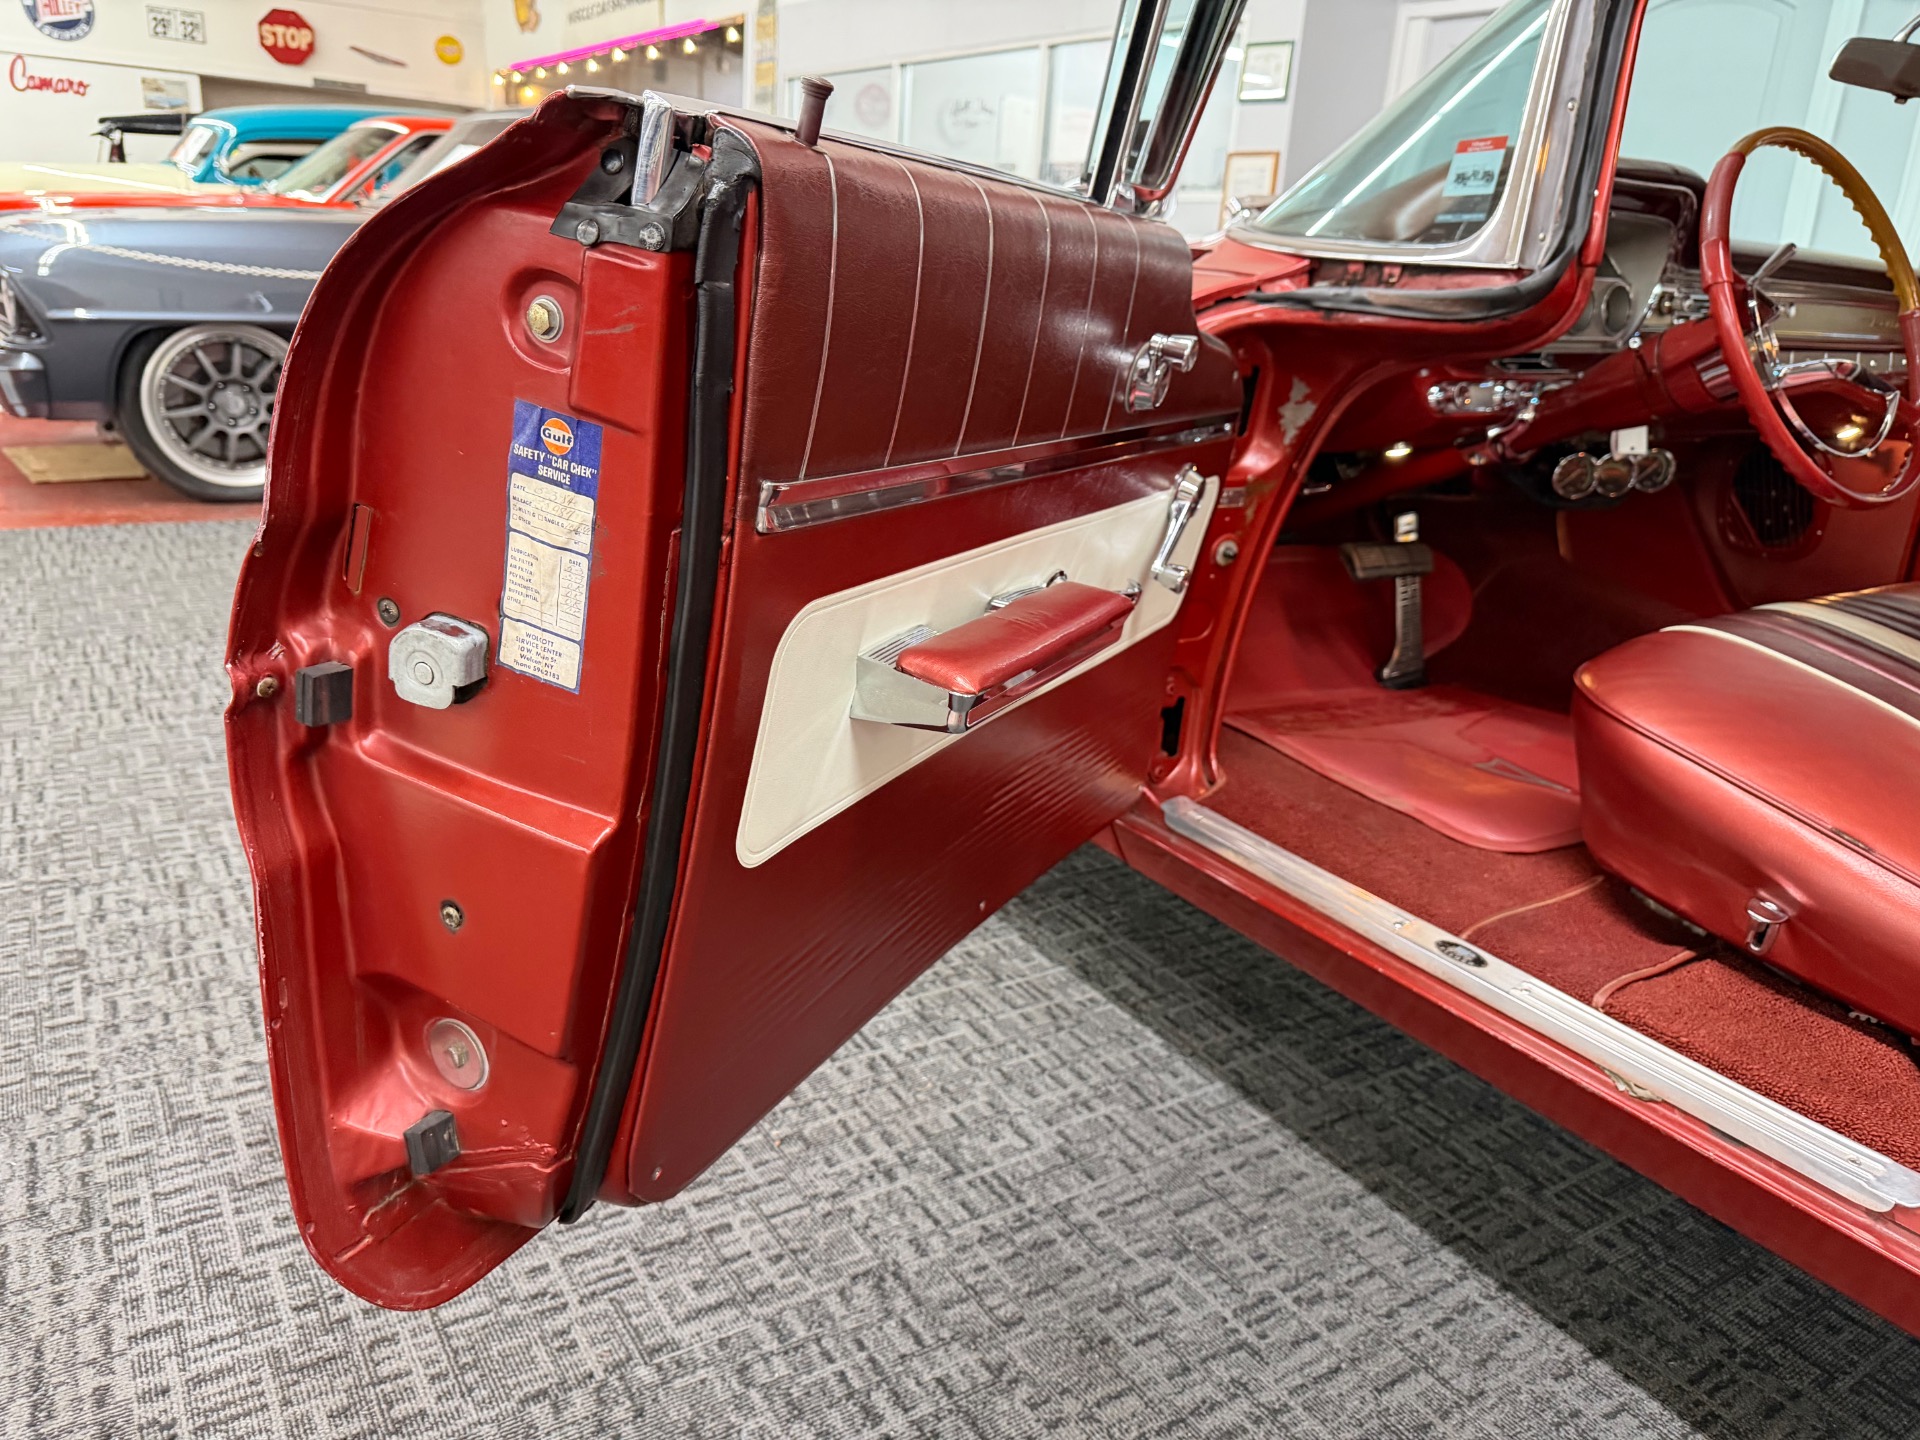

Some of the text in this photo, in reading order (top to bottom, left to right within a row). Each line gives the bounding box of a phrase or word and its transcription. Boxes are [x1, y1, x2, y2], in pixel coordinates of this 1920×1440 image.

[260, 23, 312, 51] STOP
[9, 53, 90, 96] Camaro
[542, 427, 573, 446] Gulf
[513, 443, 546, 462] SAFETY
[570, 462, 598, 479] CHEK"
[538, 464, 571, 485] SERVICE
[525, 631, 554, 648] WOLCOTT
[513, 658, 532, 670] Phone
[544, 660, 554, 670] NY
